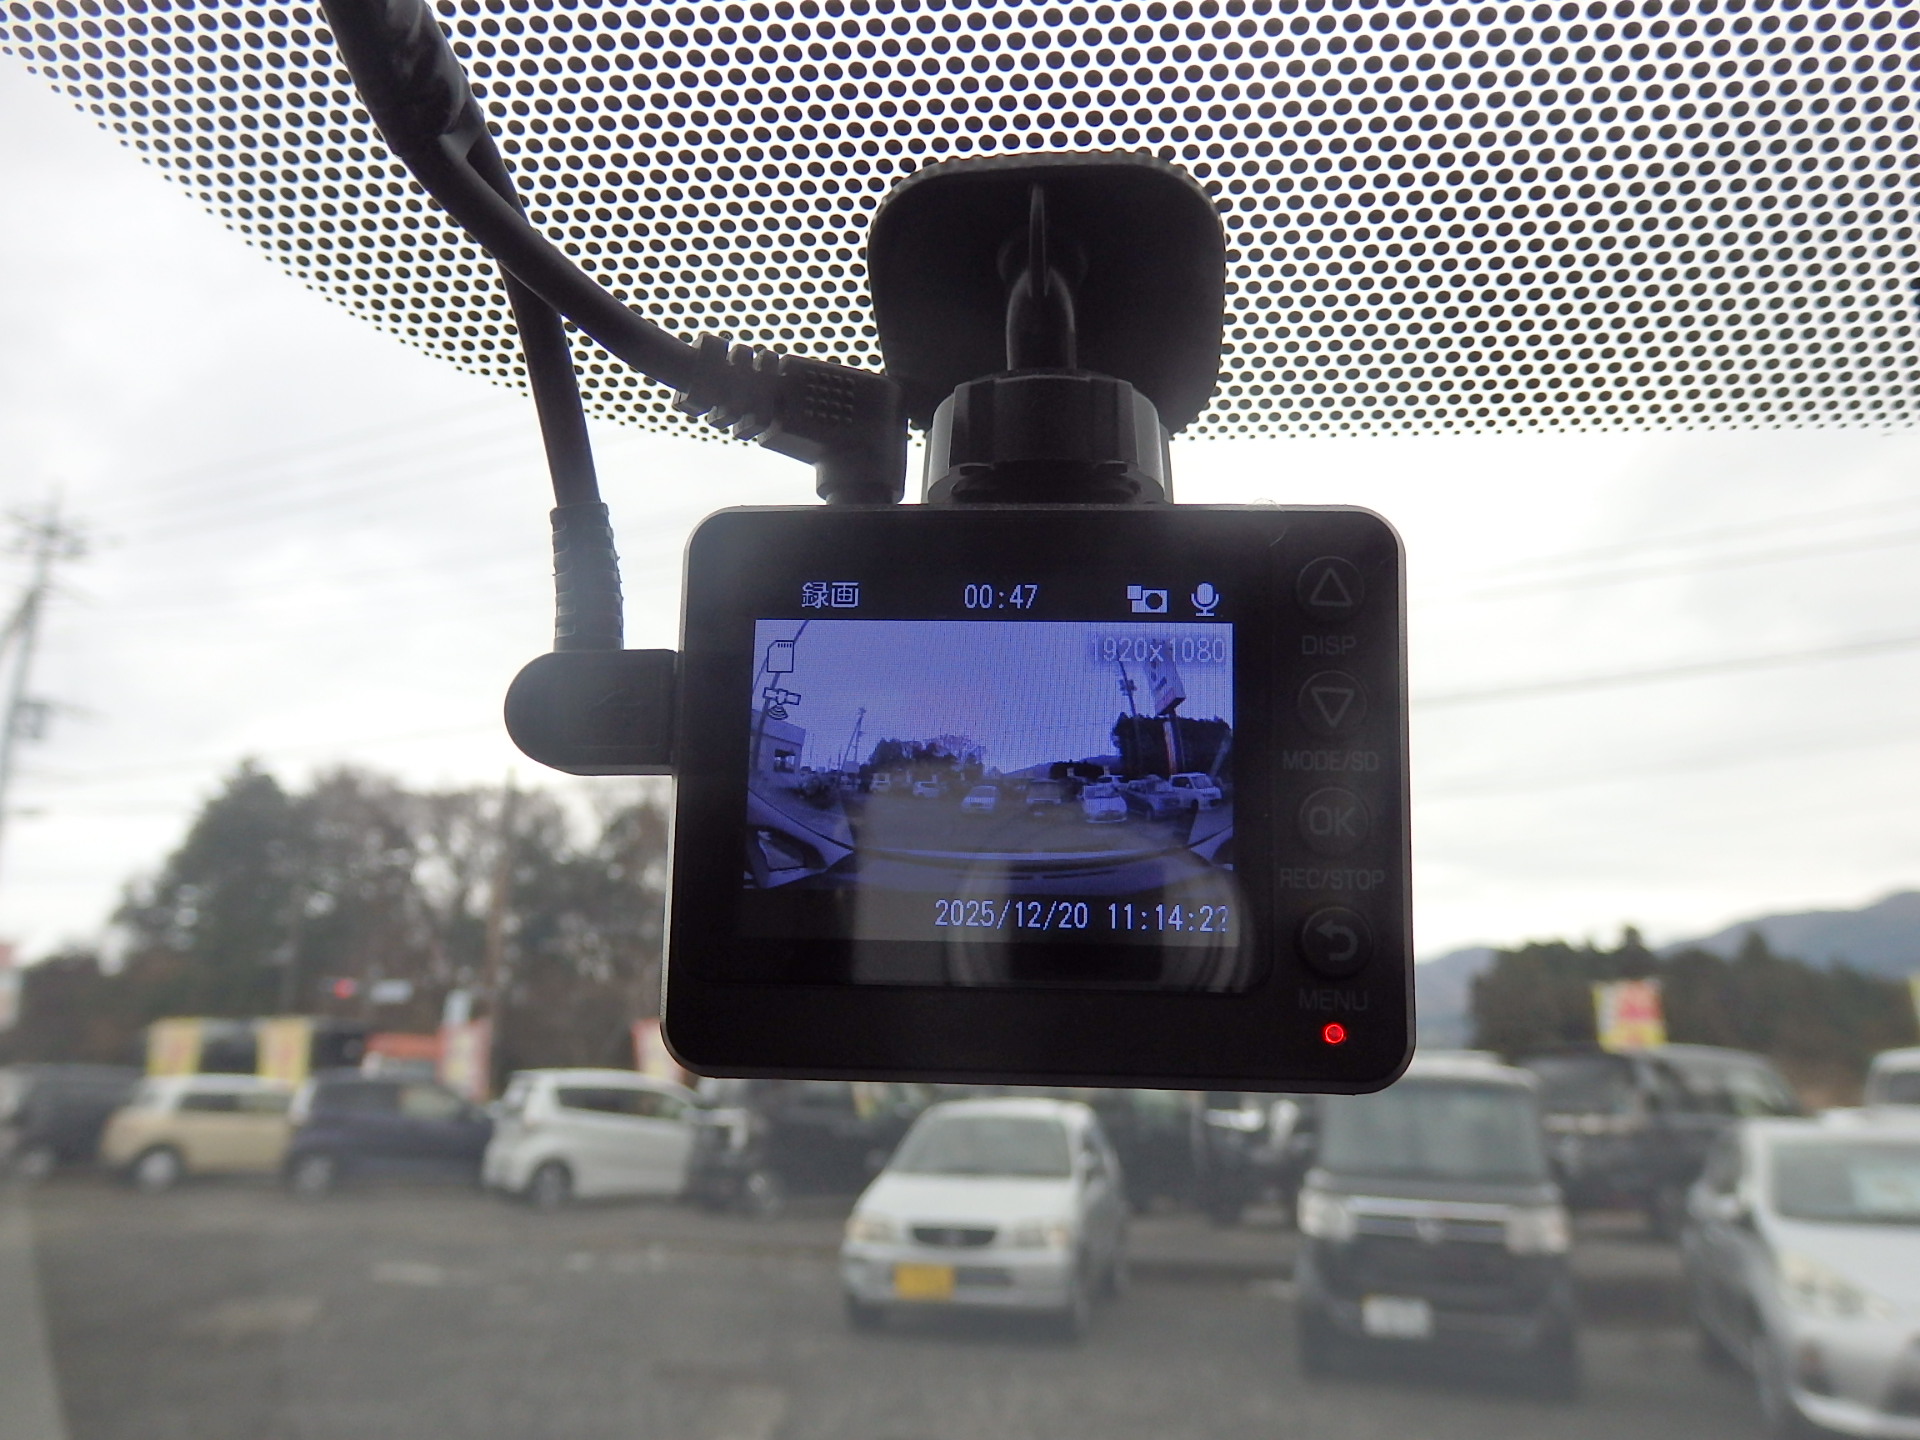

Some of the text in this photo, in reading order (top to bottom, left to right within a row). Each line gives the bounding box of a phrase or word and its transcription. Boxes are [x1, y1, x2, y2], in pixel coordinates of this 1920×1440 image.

[801, 581, 859, 609] 録画
[963, 584, 1038, 610] 00:47
[1091, 637, 1226, 663] 1920x1080
[1302, 635, 1357, 655] DISP
[1282, 751, 1380, 772] MODE/SD
[1308, 806, 1356, 836] OK
[1280, 868, 1385, 891] REC/STOP
[934, 899, 1088, 930] 2025/12/20
[1300, 989, 1368, 1012] MENU
